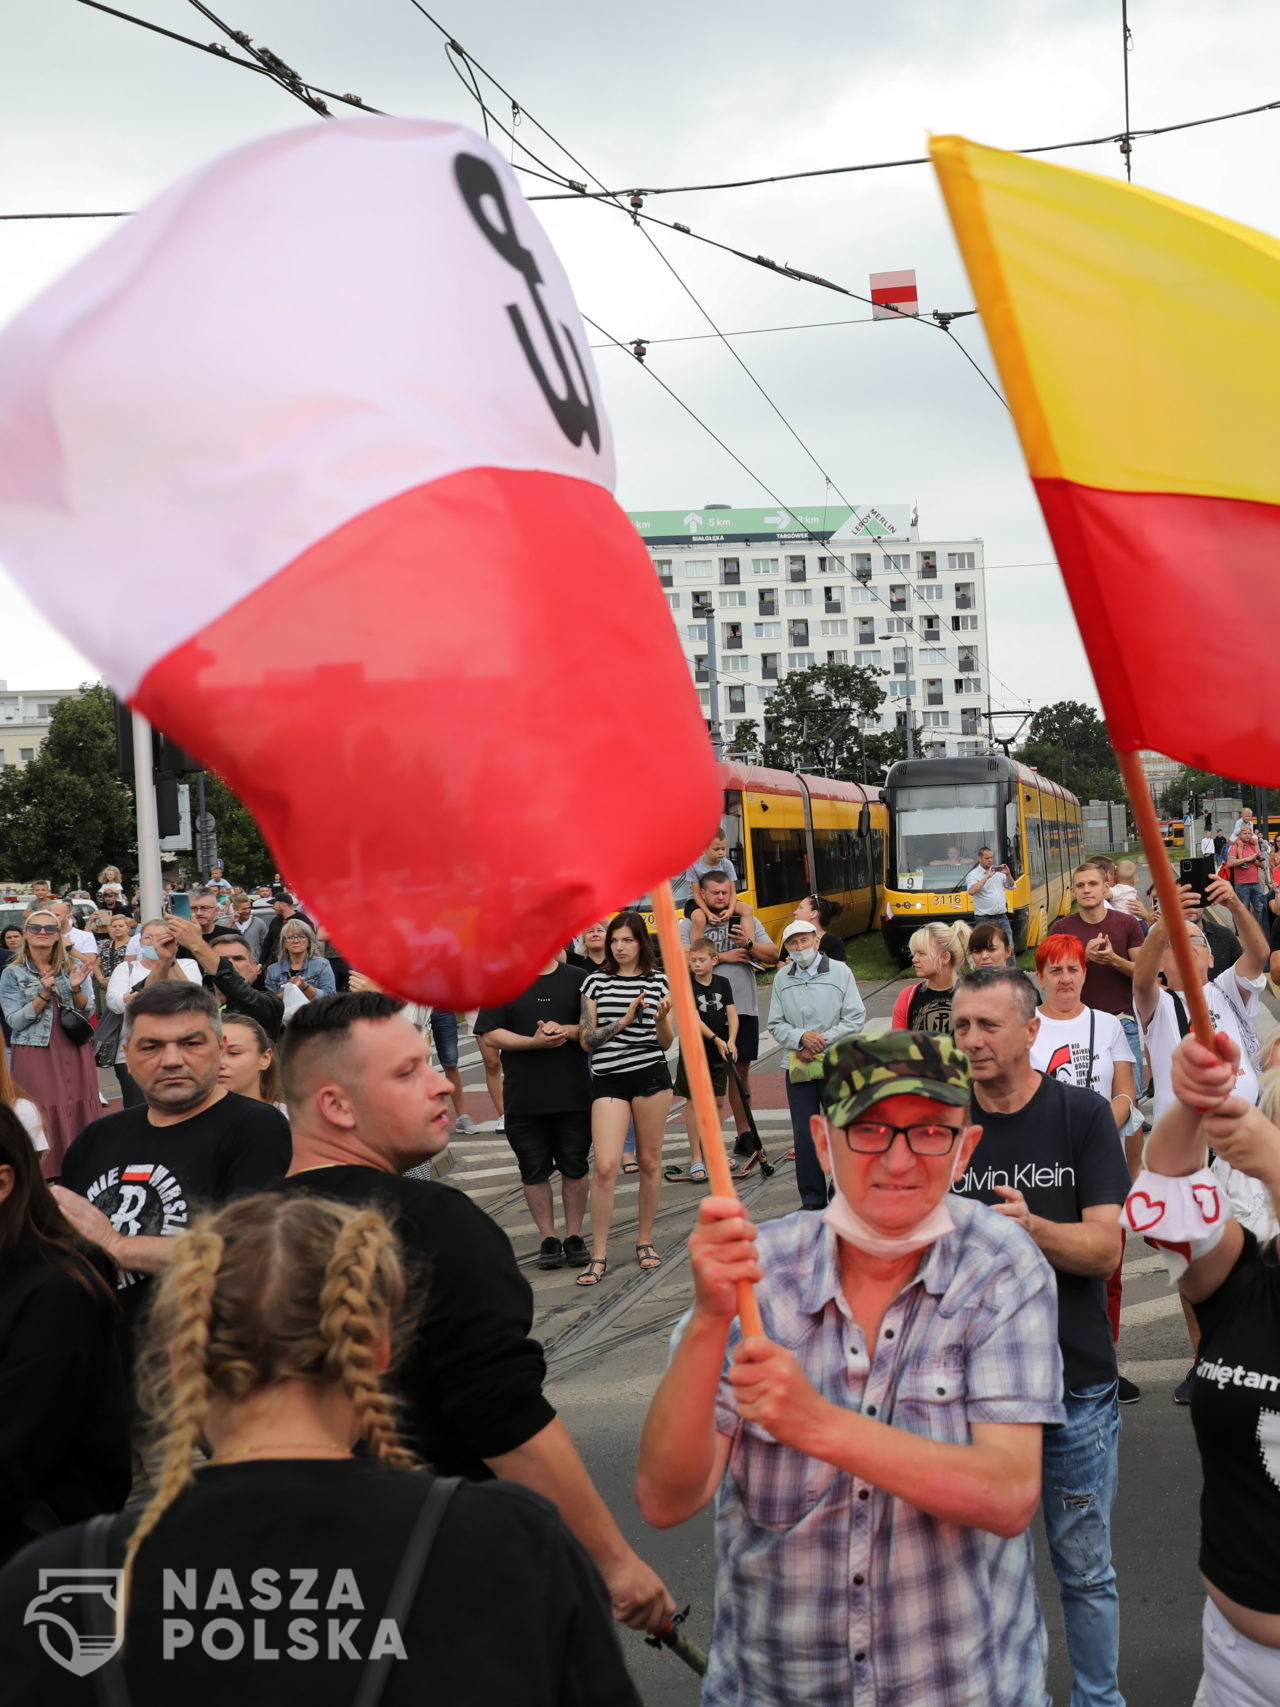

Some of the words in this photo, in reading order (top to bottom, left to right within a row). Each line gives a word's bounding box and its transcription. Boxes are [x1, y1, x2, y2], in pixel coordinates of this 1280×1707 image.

[708, 518, 714, 527] 5
[716, 518, 731, 527] km
[805, 515, 819, 524] km
[851, 514, 872, 536] LEROY
[870, 508, 897, 534] MERLIN
[906, 877, 914, 889] 9
[934, 895, 961, 905] 3116
[1075, 1062, 1089, 1070] BOGO
[951, 1165, 1009, 1194] alvin
[1014, 1162, 1075, 1189] Klein
